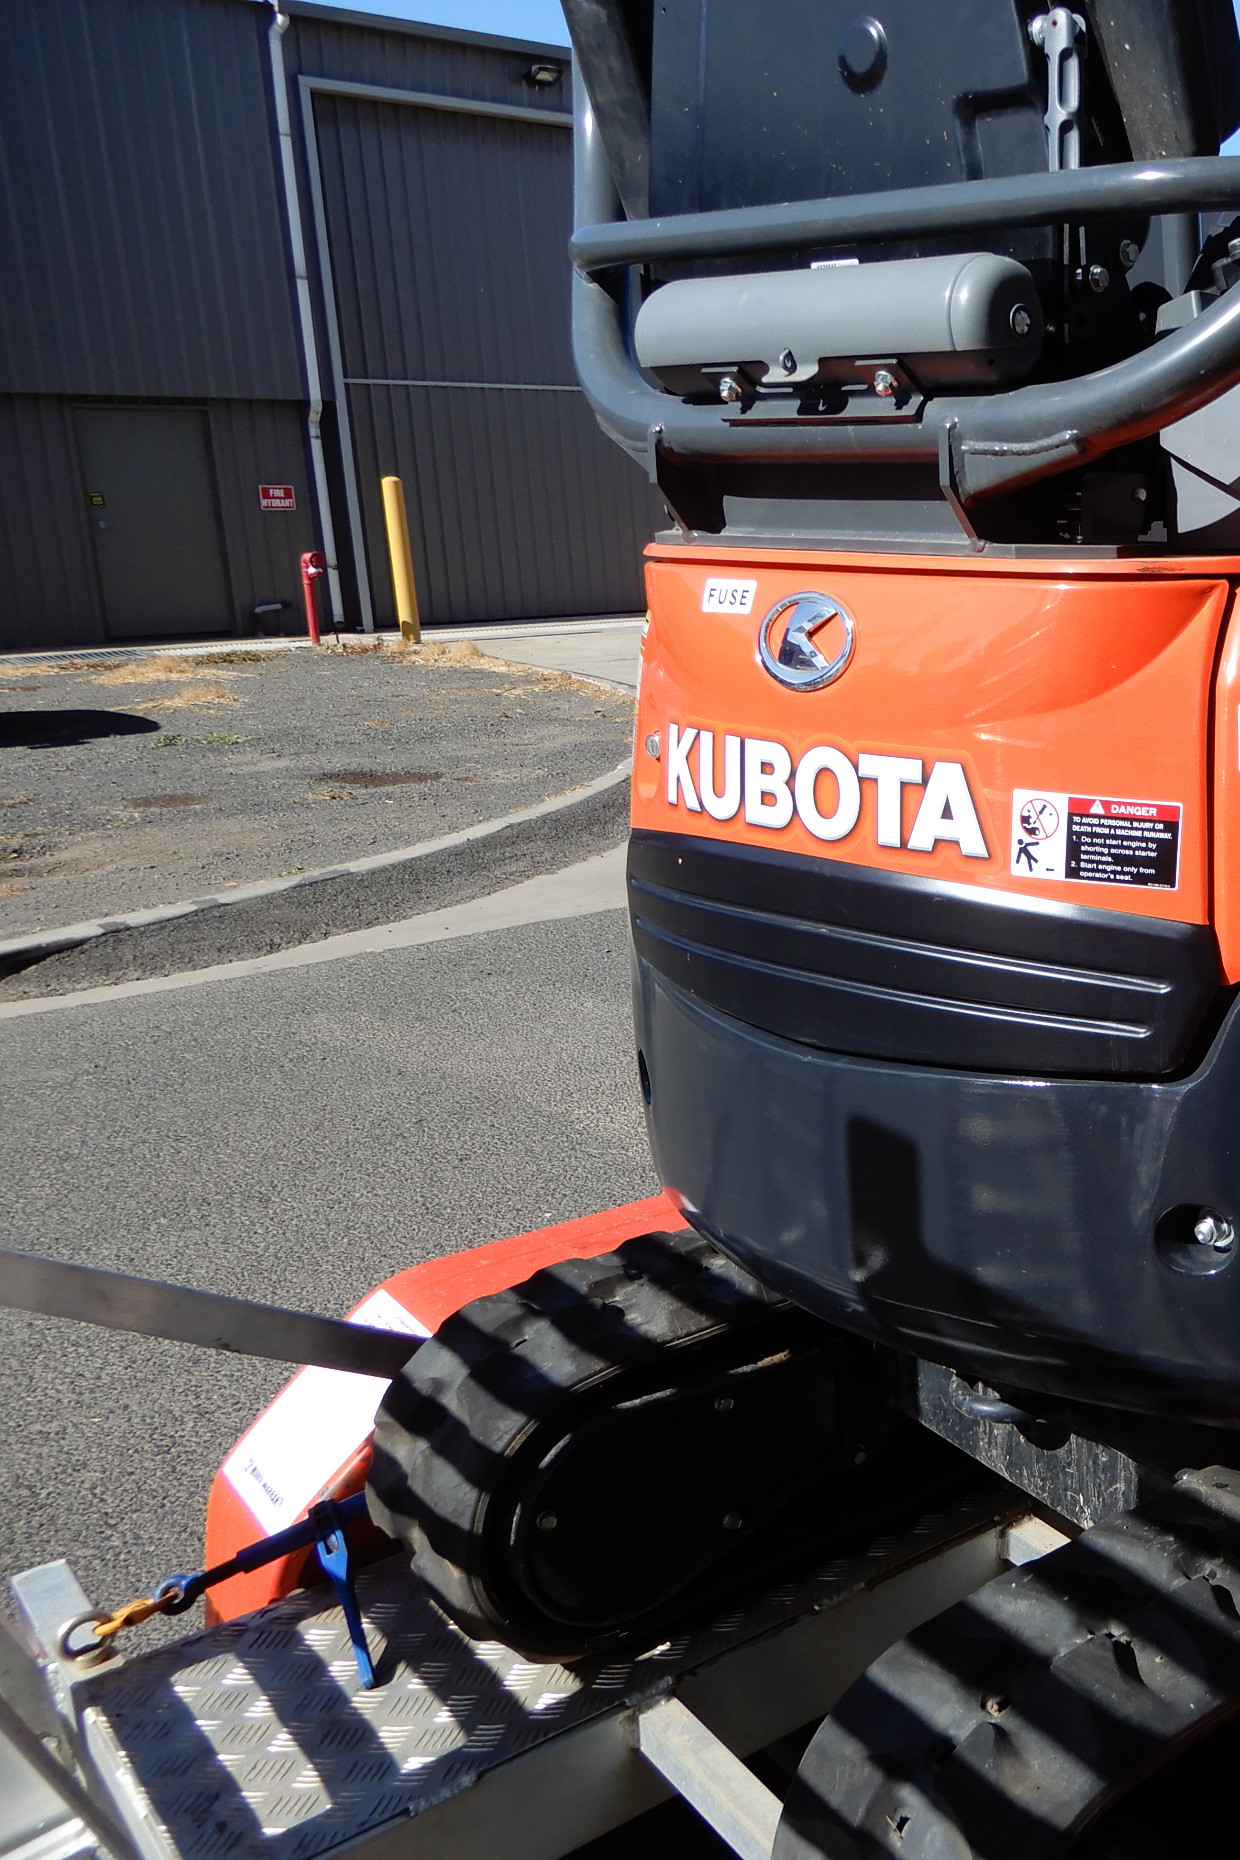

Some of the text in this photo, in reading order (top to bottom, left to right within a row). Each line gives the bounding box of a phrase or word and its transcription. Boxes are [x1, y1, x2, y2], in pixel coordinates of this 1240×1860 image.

[269, 489, 285, 497] FIRE
[262, 499, 294, 507] HYDRANT
[707, 588, 749, 605] FUSE
[667, 722, 990, 859] KUBOTA
[1110, 804, 1157, 817] DANGER
[1081, 817, 1099, 825] AVOID
[1100, 818, 1132, 828] PERSONAL
[1132, 821, 1154, 830] INJURY
[1072, 825, 1092, 833] DEATH
[1092, 826, 1110, 834] FROM
[1115, 828, 1142, 837] MACHINE
[1105, 838, 1122, 846] start
[1122, 840, 1147, 849] engine
[1148, 841, 1157, 850] by
[1080, 845, 1158, 858] shorting across starter
[1080, 853, 1114, 862] terminals.
[1080, 861, 1097, 869] Start
[1098, 863, 1122, 872] engine
[1122, 865, 1138, 874] only
[1139, 866, 1156, 875] from
[1079, 870, 1133, 881] operator's seat.
